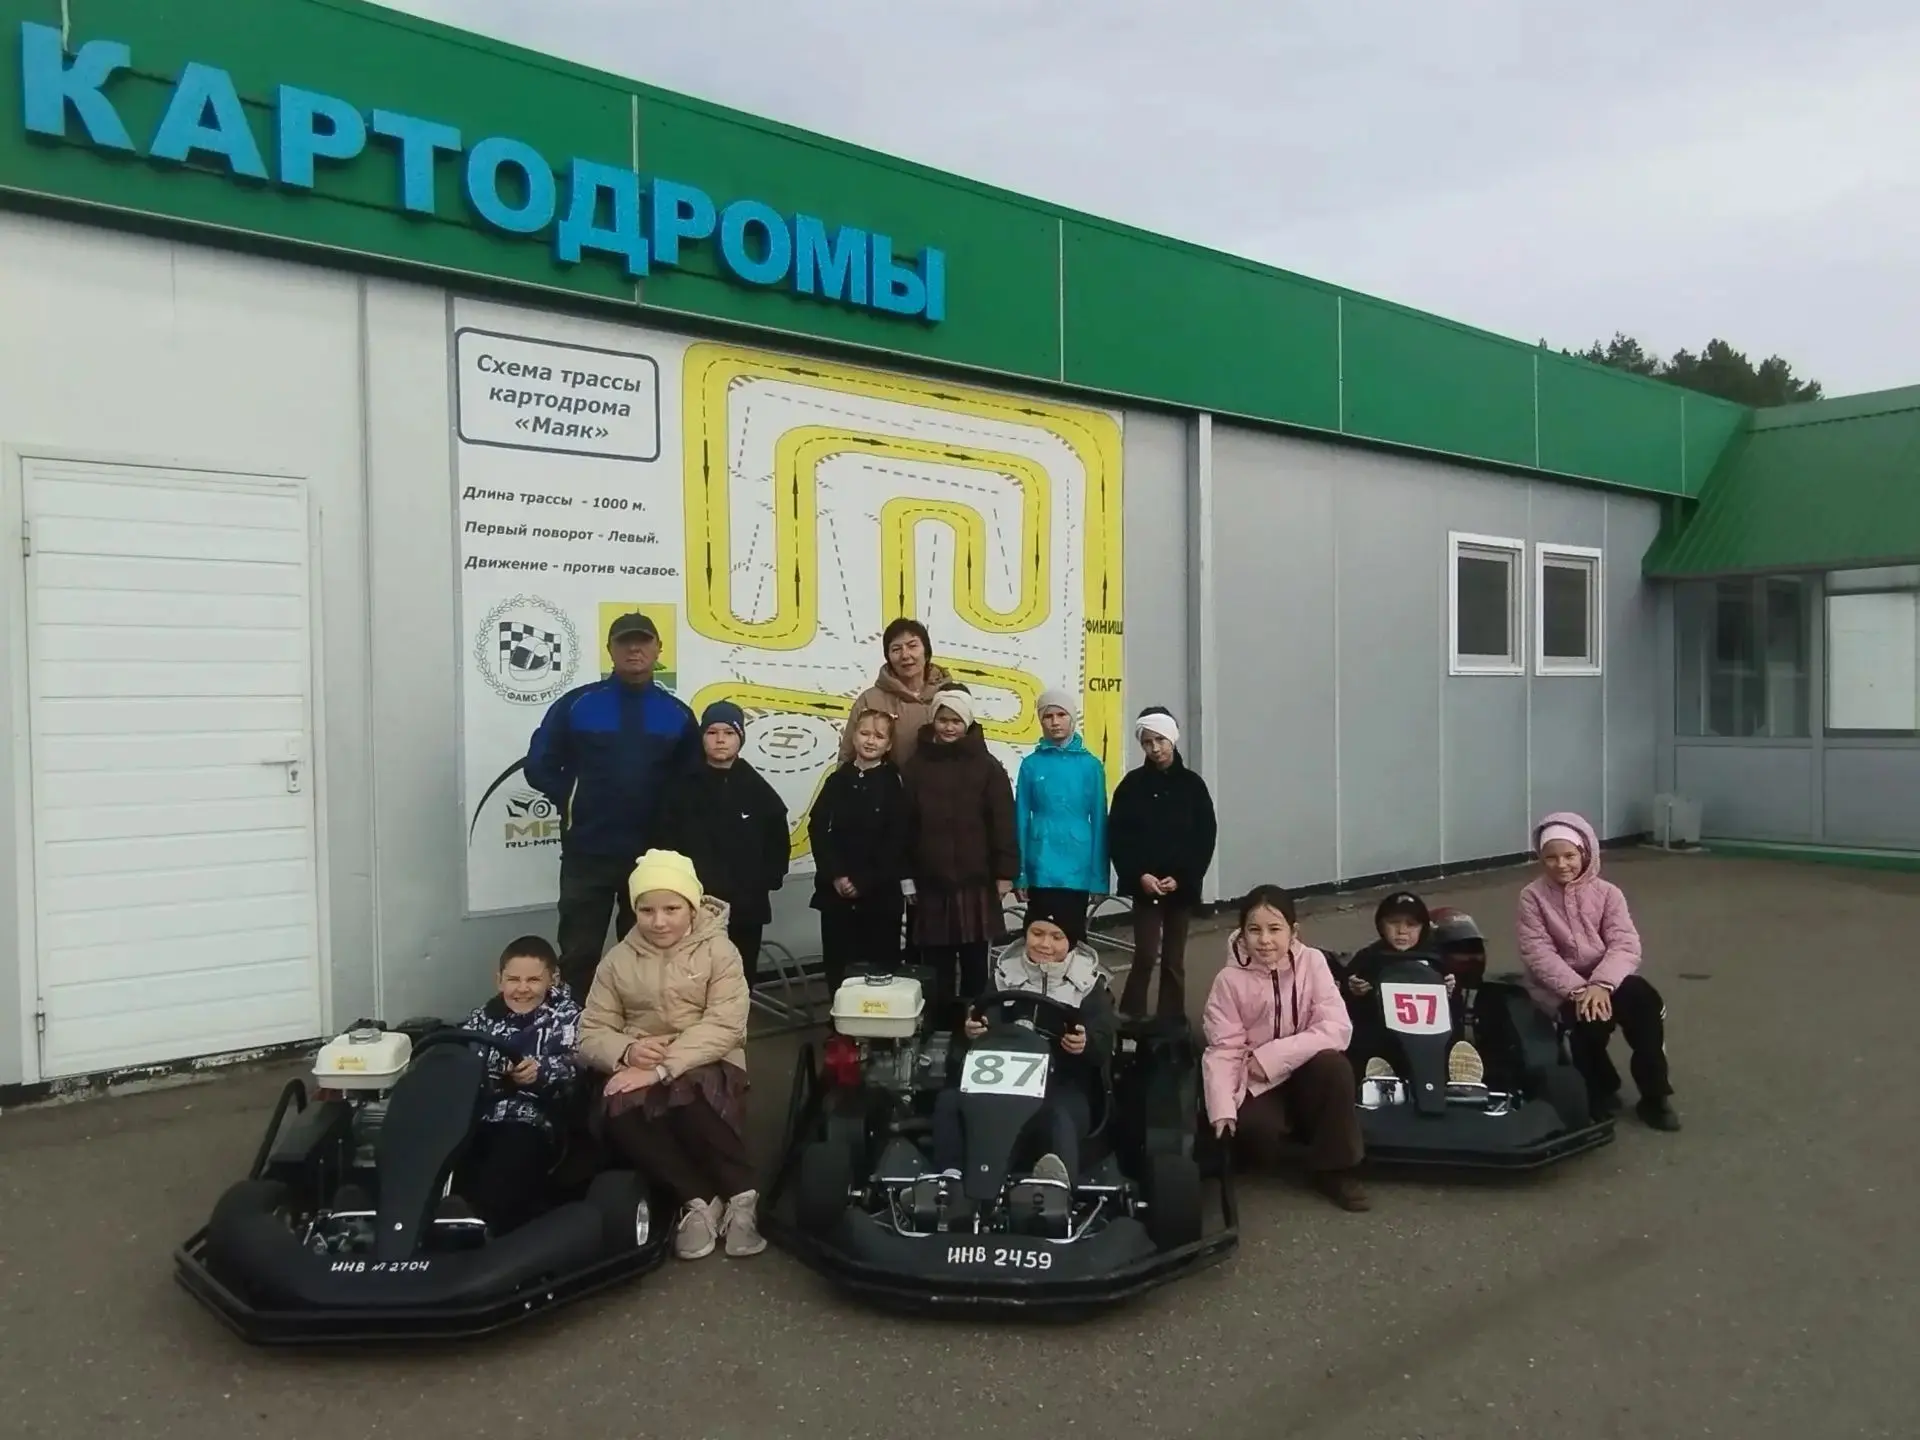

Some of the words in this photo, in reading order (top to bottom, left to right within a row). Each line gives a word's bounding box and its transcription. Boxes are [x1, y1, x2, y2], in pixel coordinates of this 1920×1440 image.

[21, 20, 945, 322] КАРТОДРОМЫ
[476, 354, 552, 381] Схема
[560, 369, 641, 393] трассы
[489, 386, 631, 417] картодрома
[515, 416, 609, 439] «Маяк»
[463, 486, 515, 501] Длина
[519, 493, 573, 506] трассы
[593, 497, 628, 510] 1000
[632, 501, 646, 511] м.
[464, 521, 528, 536] Первый
[532, 527, 594, 542] поворот
[607, 530, 659, 544] Левый.
[464, 556, 548, 571] Движение
[563, 562, 615, 575] против
[620, 565, 680, 577] часавое.
[1085, 618, 1124, 635] ФИНИШ
[1088, 677, 1122, 692] СТАРТ
[507, 692, 538, 702] ФАМС
[540, 691, 552, 700] РТ
[1394, 993, 1437, 1025] 57
[971, 1054, 1043, 1087] 87
[331, 1261, 366, 1272] ИНВ
[389, 1261, 430, 1272] 2704
[947, 1246, 987, 1263] ИНВ
[994, 1248, 1052, 1269] 2459
